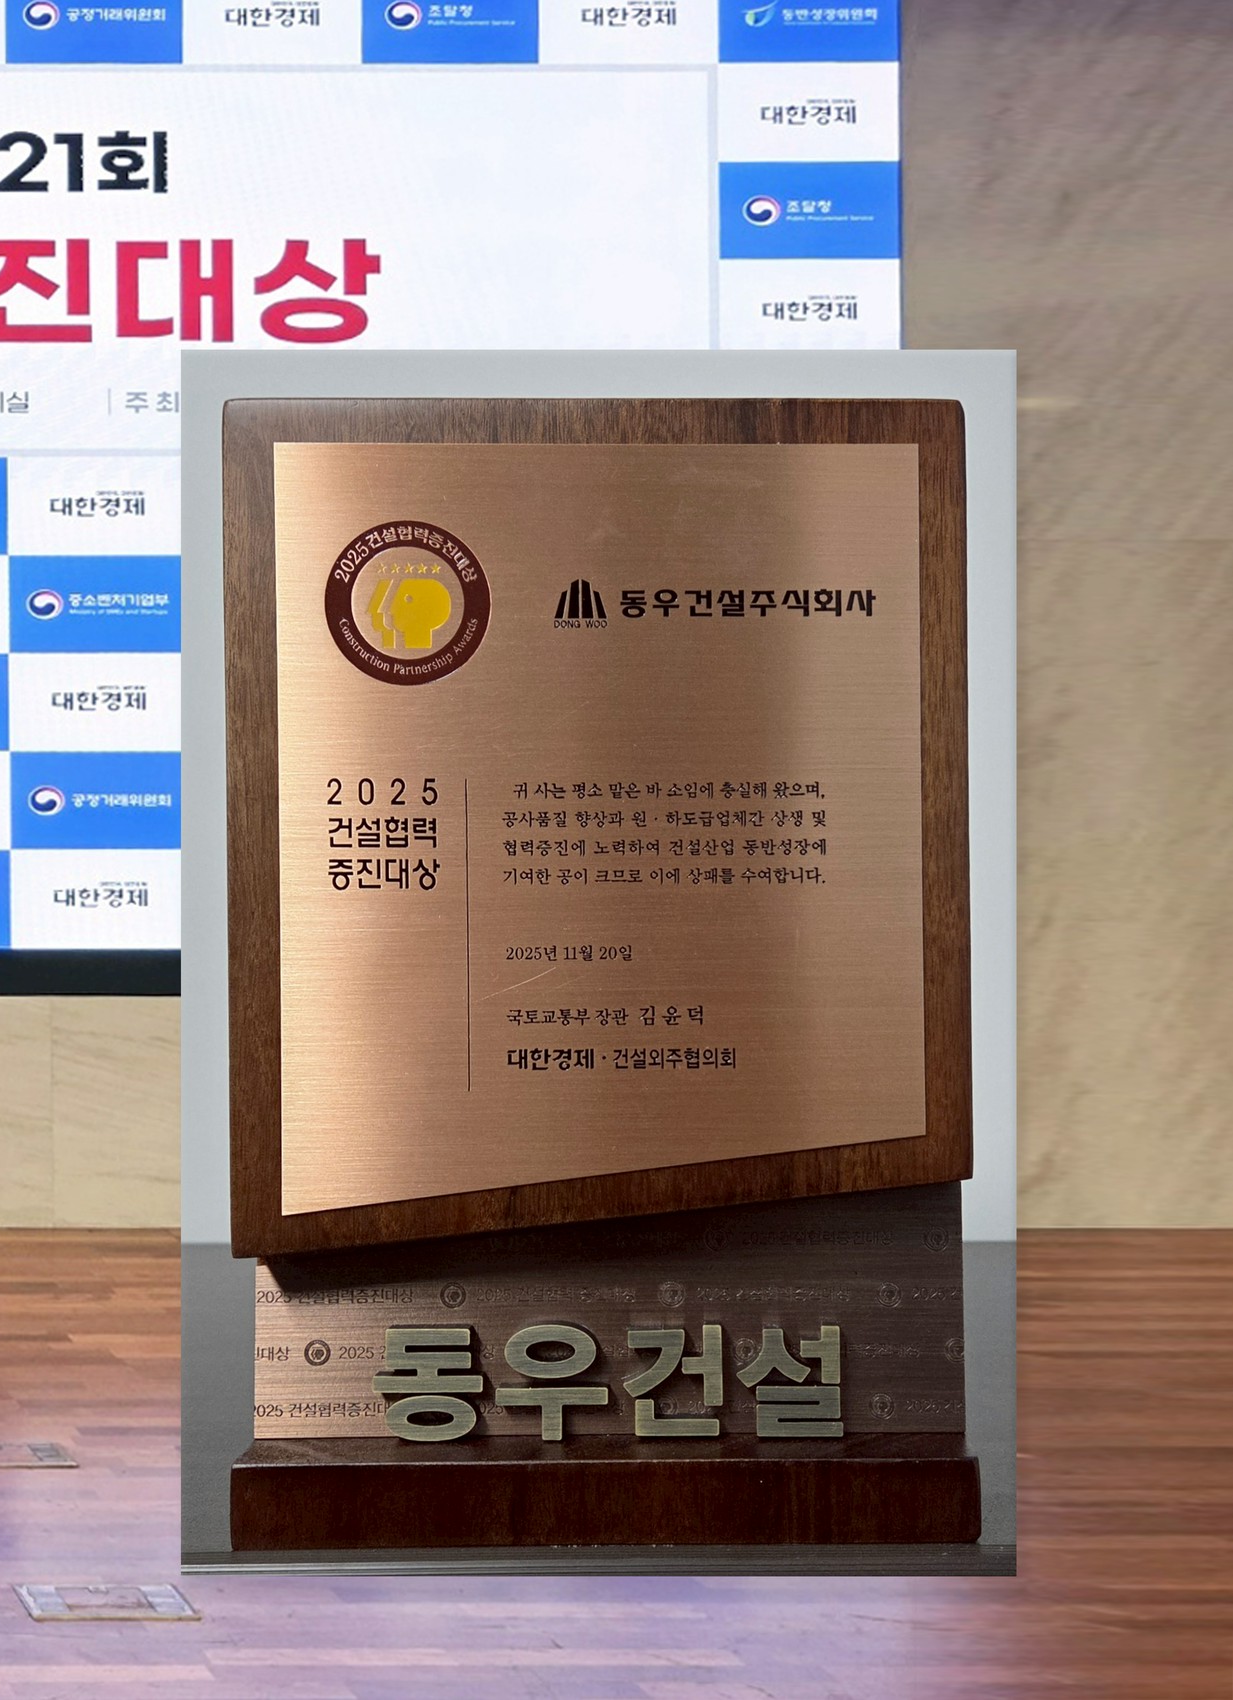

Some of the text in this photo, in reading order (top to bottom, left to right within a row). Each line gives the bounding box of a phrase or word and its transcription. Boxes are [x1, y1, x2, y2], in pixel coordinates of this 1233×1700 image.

[67, 8, 165, 21] 공정거래위원회
[226, 8, 319, 27] 대한경제
[429, 5, 473, 18] 조달청
[582, 7, 676, 26] 대한경제
[783, 8, 877, 21] 동반성장위원회
[760, 105, 857, 126] 대한경제
[787, 201, 831, 213] 조달청
[763, 302, 857, 321] 대한경제
[50, 497, 145, 517] 대한경제
[334, 525, 479, 584] 2025 건설협력증진대상
[69, 594, 168, 607] 중소벤처기업부
[620, 589, 876, 618] 동우건설주식회사
[553, 620, 608, 629] DONG WOO
[339, 616, 479, 676] Construction Partnership Awards
[52, 692, 146, 711] 대한경제
[513, 781, 825, 800] 귀 사는 평소 맡은 바 소임에 충실해 왔으며,
[72, 794, 171, 807] 공정거래위원회
[502, 811, 567, 828] 공사품질
[575, 810, 624, 829] 향상과
[631, 811, 647, 828] 원
[666, 810, 764, 829] 하도급업체간
[771, 810, 802, 828] 상생
[812, 810, 826, 828] 및
[327, 816, 437, 849] 건설협력
[503, 838, 827, 857] 협력증진에 노력하여 건설산업 동반성장에
[327, 858, 440, 891] 증진대상
[503, 867, 826, 886] 기여한 공이 크므로 이에 상패를 수여합니다.
[54, 888, 148, 907] 대한경제
[506, 945, 633, 962] 2025년 11월 20일
[506, 1007, 591, 1028] 국토교통부
[596, 1008, 628, 1028] 장관
[507, 1048, 594, 1071] 대한경제
[613, 1047, 735, 1069] 건설외주협의회
[257, 1290, 293, 1304] 2025
[339, 1347, 374, 1360] 2025
[373, 1324, 844, 1441] 동우건설
